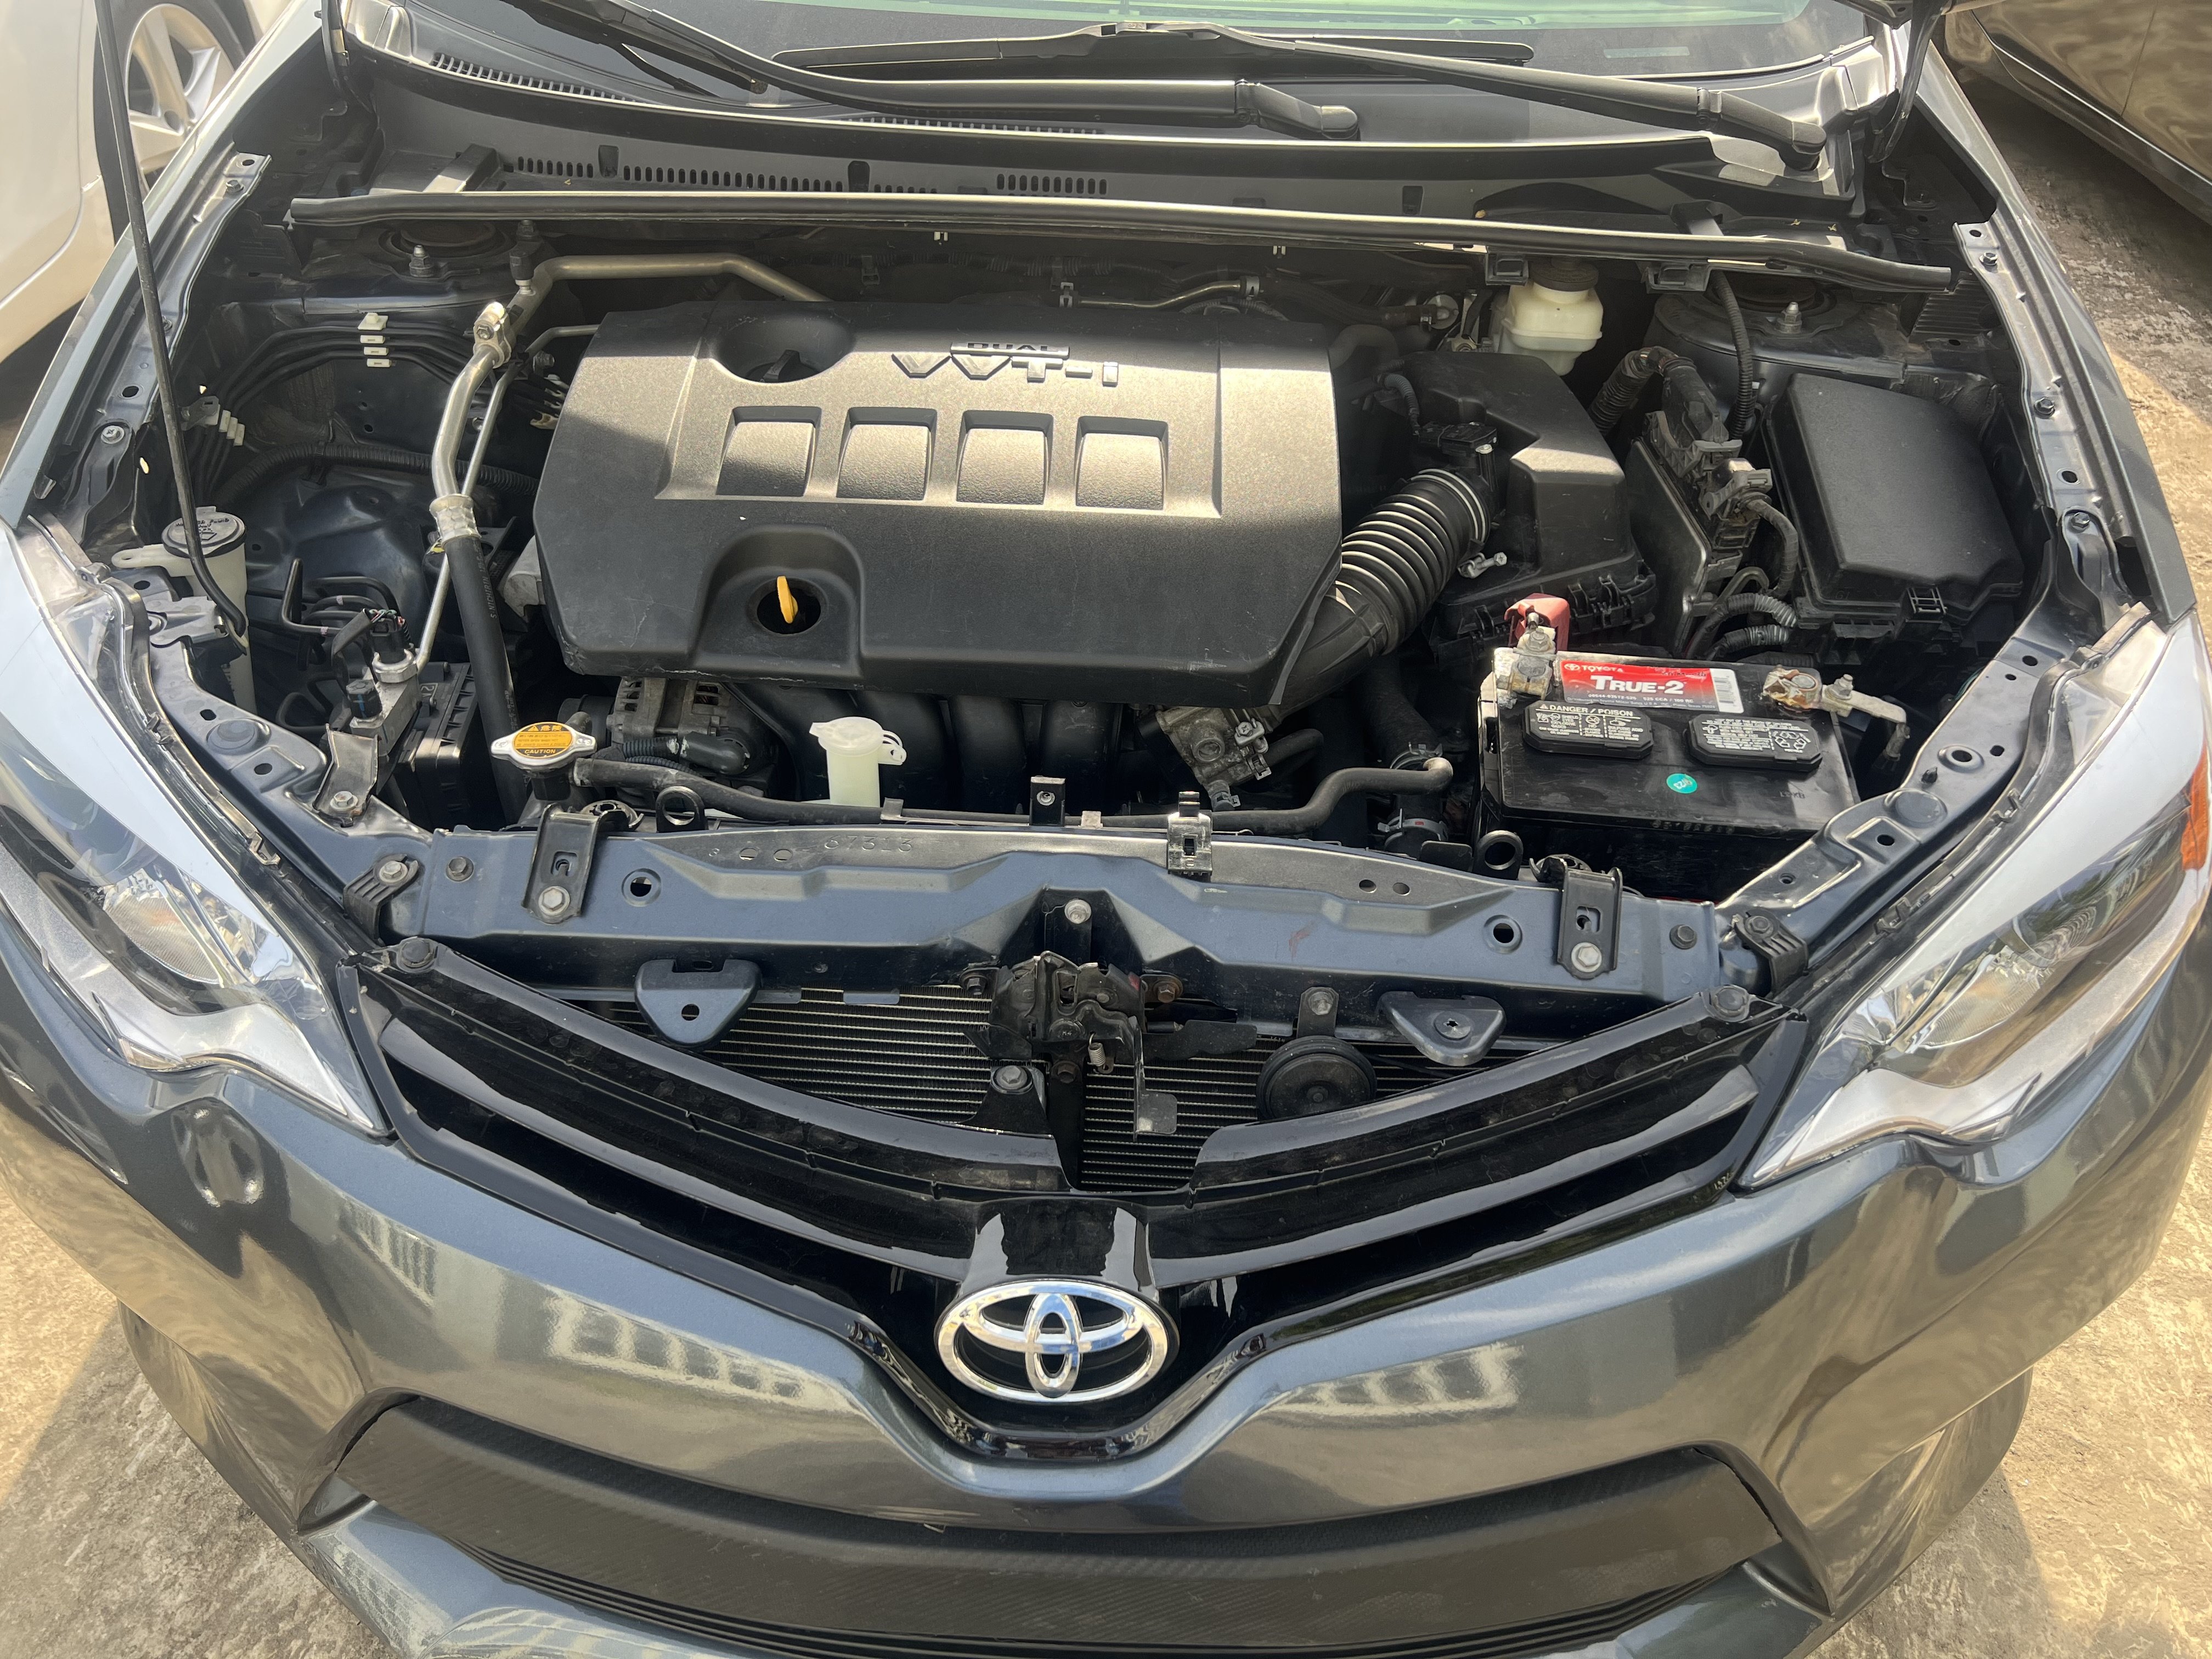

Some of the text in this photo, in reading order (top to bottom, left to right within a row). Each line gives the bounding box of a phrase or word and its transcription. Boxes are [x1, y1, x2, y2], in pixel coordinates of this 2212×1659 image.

[967, 342, 1059, 351] DUAL
[1590, 675, 1684, 695] TRUE-2
[1549, 704, 1588, 713] DANGER
[1598, 708, 1633, 716] POISON
[824, 834, 913, 853] 67313
